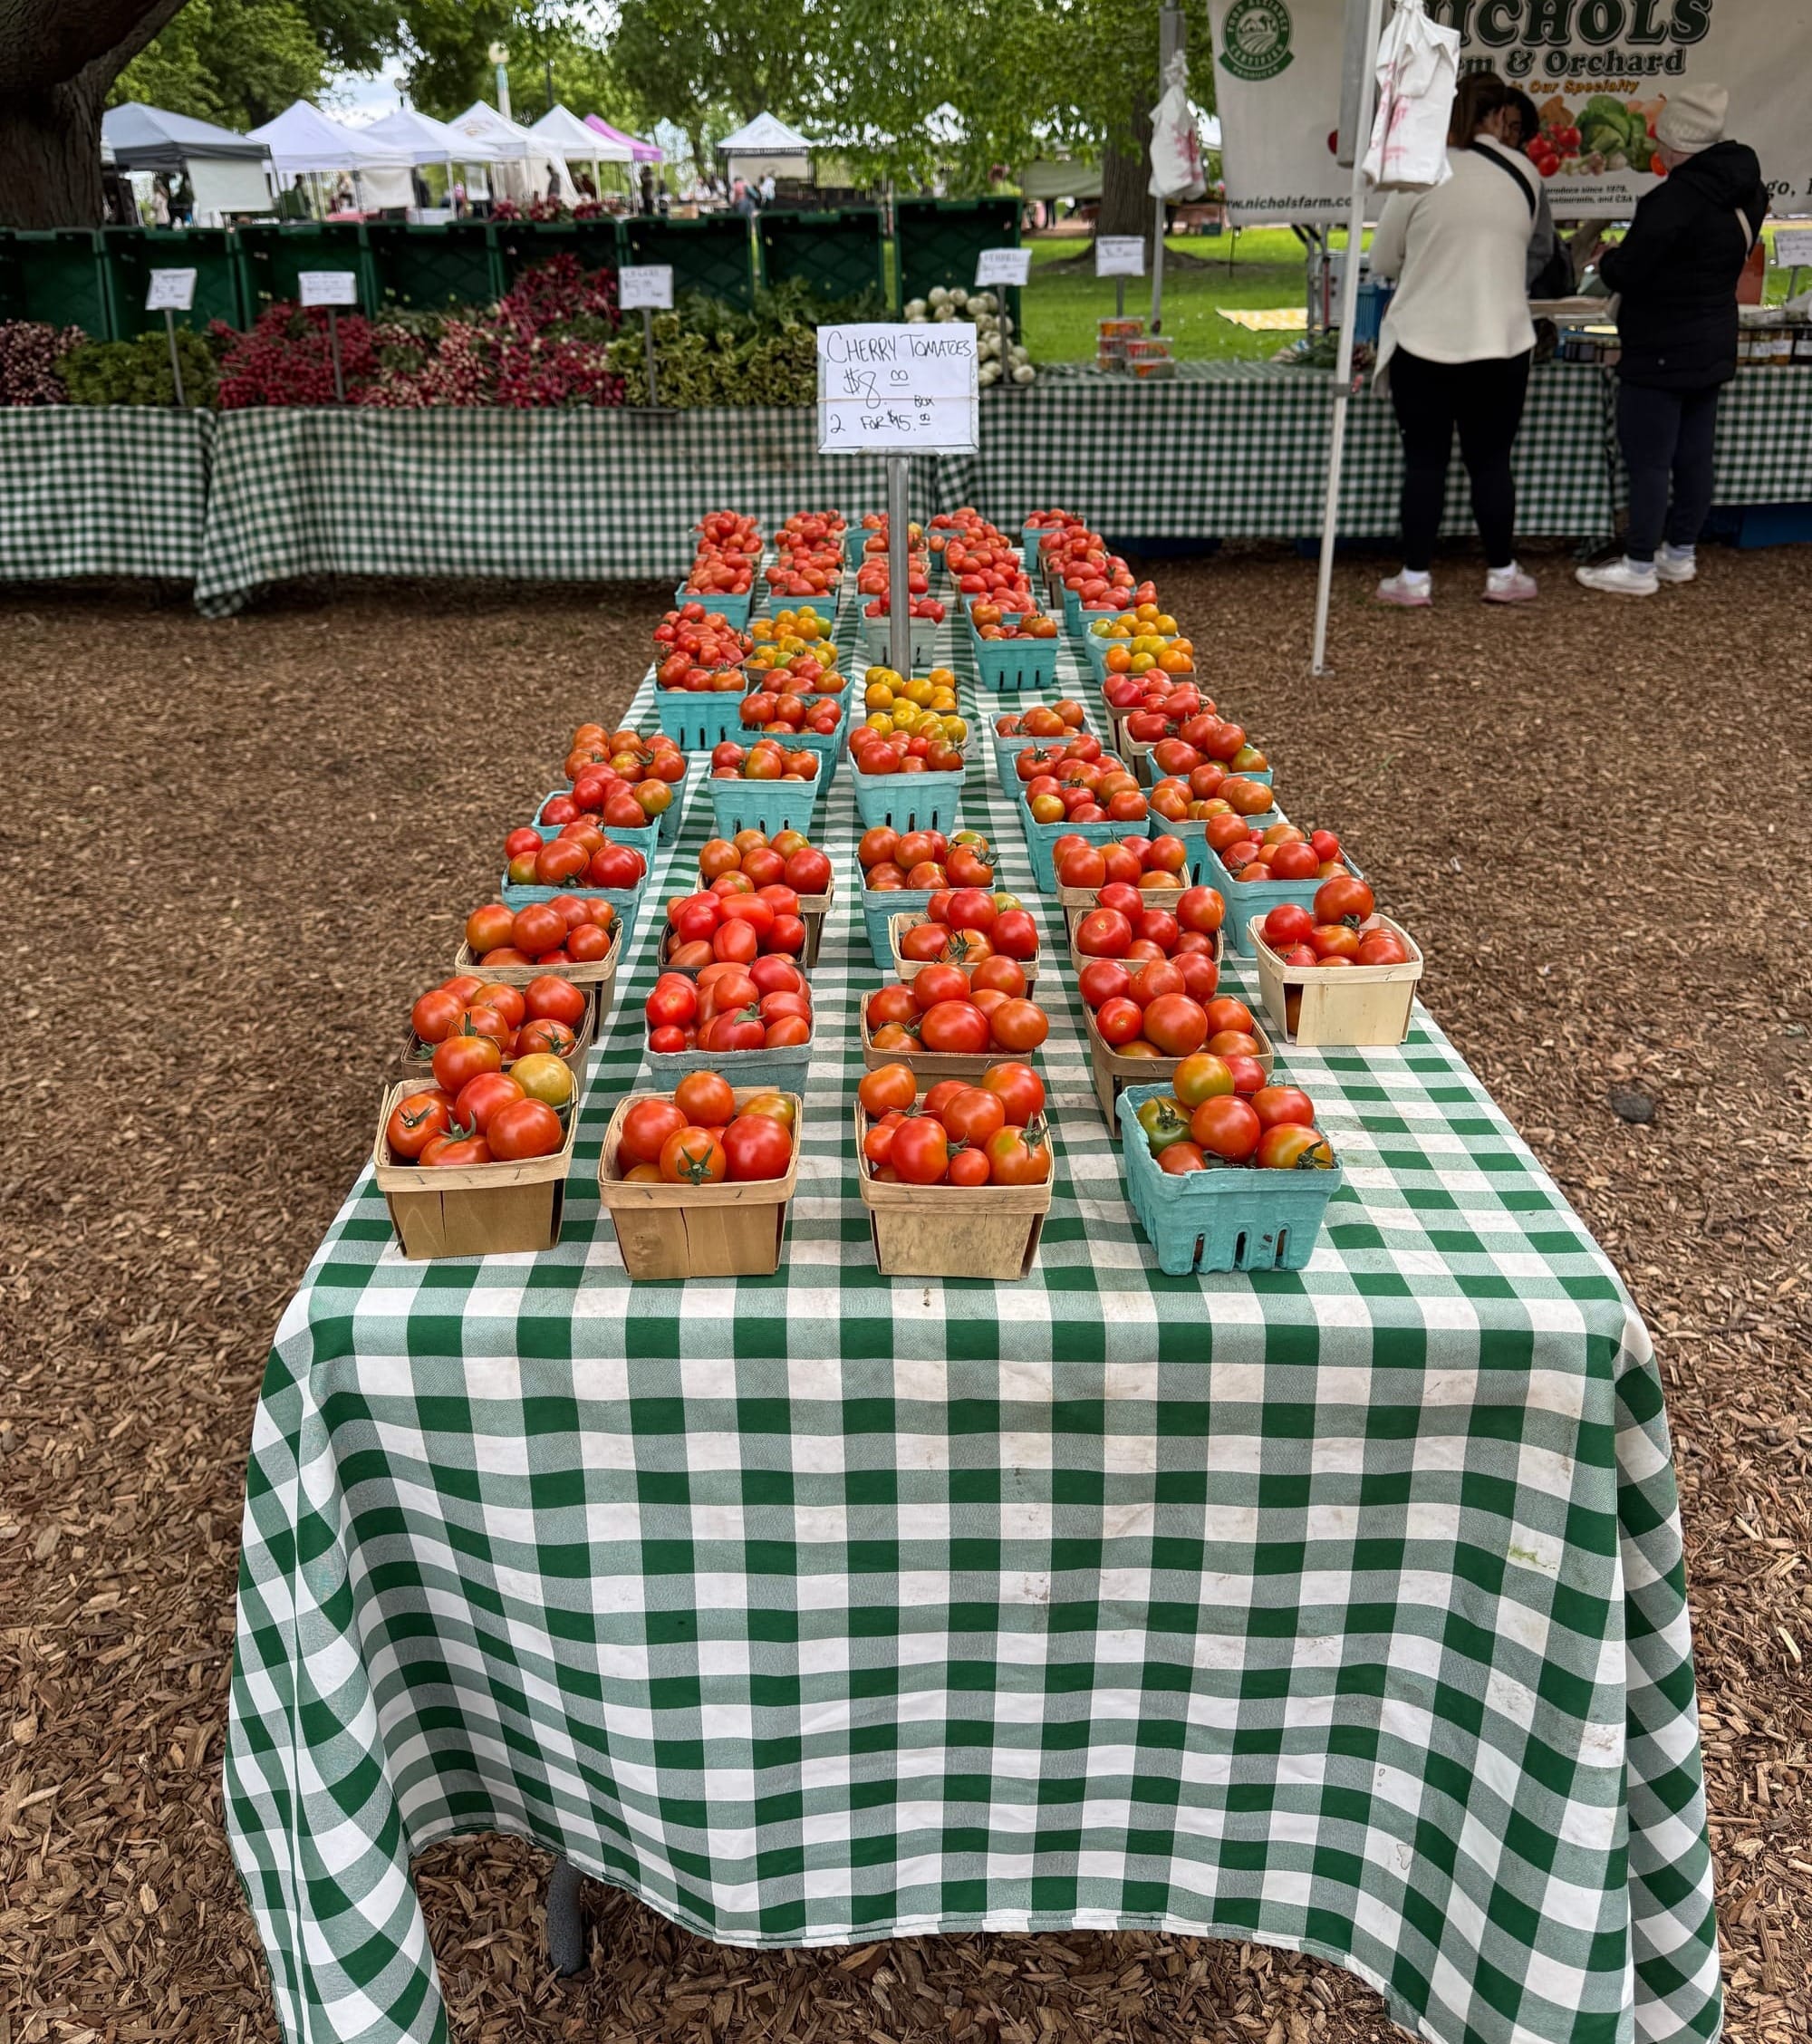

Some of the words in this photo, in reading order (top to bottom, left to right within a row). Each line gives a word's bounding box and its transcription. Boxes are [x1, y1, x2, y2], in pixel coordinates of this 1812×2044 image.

[1506, 48, 1535, 76] &
[1543, 46, 1686, 76] Orchard
[1528, 79, 1559, 94] Our
[1563, 78, 1640, 96] Specialty
[826, 331, 897, 363] CHERRY
[900, 333, 972, 358] TOMATOES
[830, 413, 846, 434] 2
